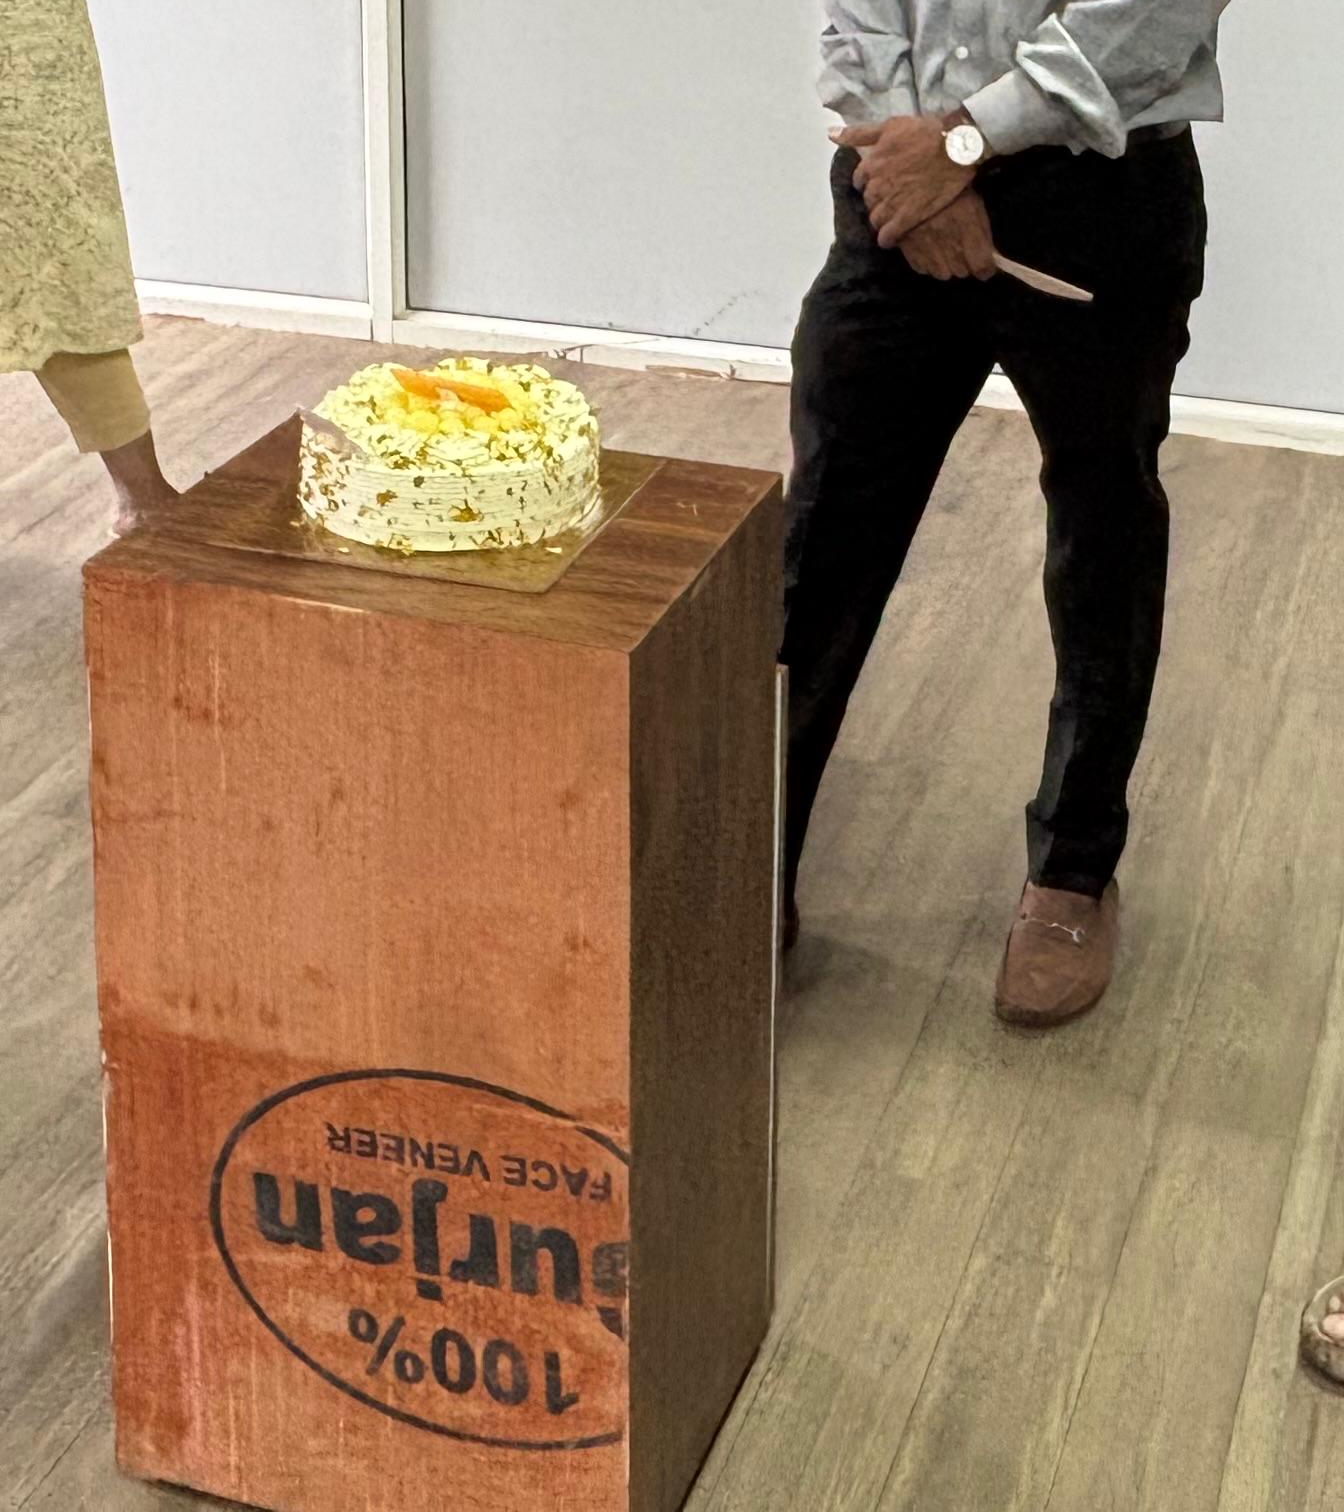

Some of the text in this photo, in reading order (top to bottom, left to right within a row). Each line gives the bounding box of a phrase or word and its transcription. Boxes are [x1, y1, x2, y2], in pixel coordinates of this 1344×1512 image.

[325, 1121, 613, 1203] FACE VENEER
[347, 1308, 580, 1416] 100%
